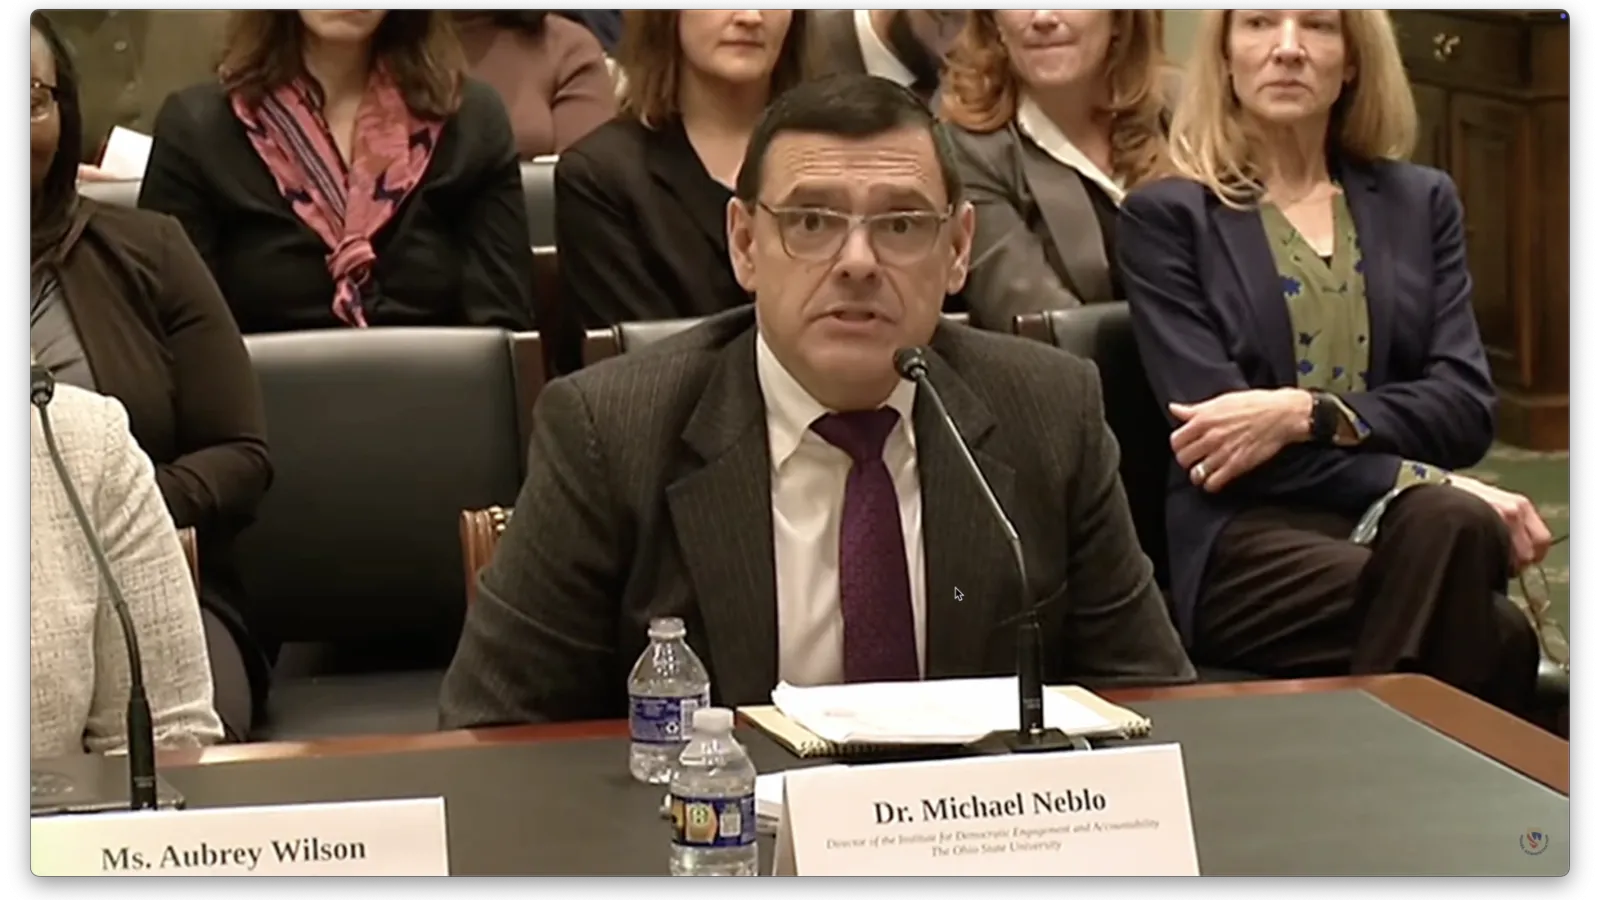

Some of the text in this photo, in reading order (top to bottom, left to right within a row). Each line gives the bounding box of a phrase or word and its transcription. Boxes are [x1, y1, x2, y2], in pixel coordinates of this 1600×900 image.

[873, 788, 1107, 825] Dr. Michael Neblo
[881, 835, 895, 845] the
[1073, 823, 1090, 833] and
[101, 837, 366, 871] Ms. Aubrey Wilson
[931, 840, 1062, 857] The Ohio State University
